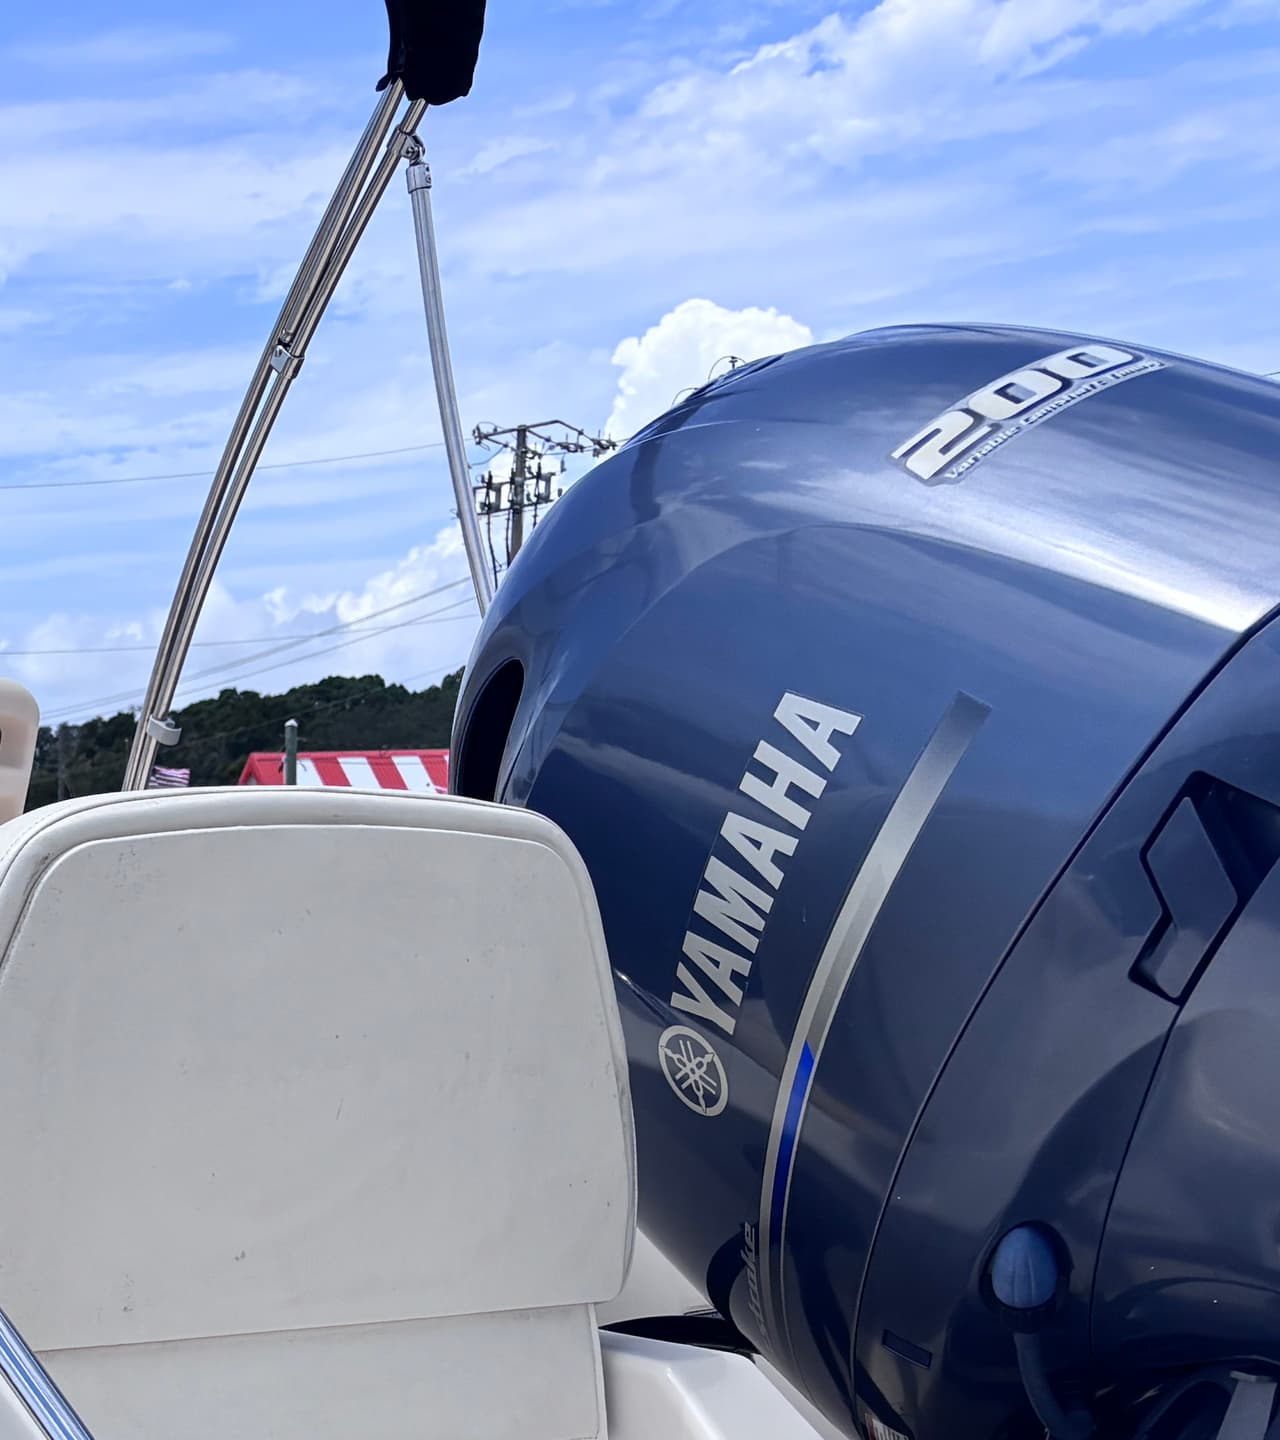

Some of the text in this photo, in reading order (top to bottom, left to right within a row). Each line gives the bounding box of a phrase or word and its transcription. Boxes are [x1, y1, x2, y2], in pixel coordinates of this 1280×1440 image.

[889, 344, 1137, 481] 200
[944, 426, 1021, 478] Variable
[671, 692, 862, 1035] YAMAHA
